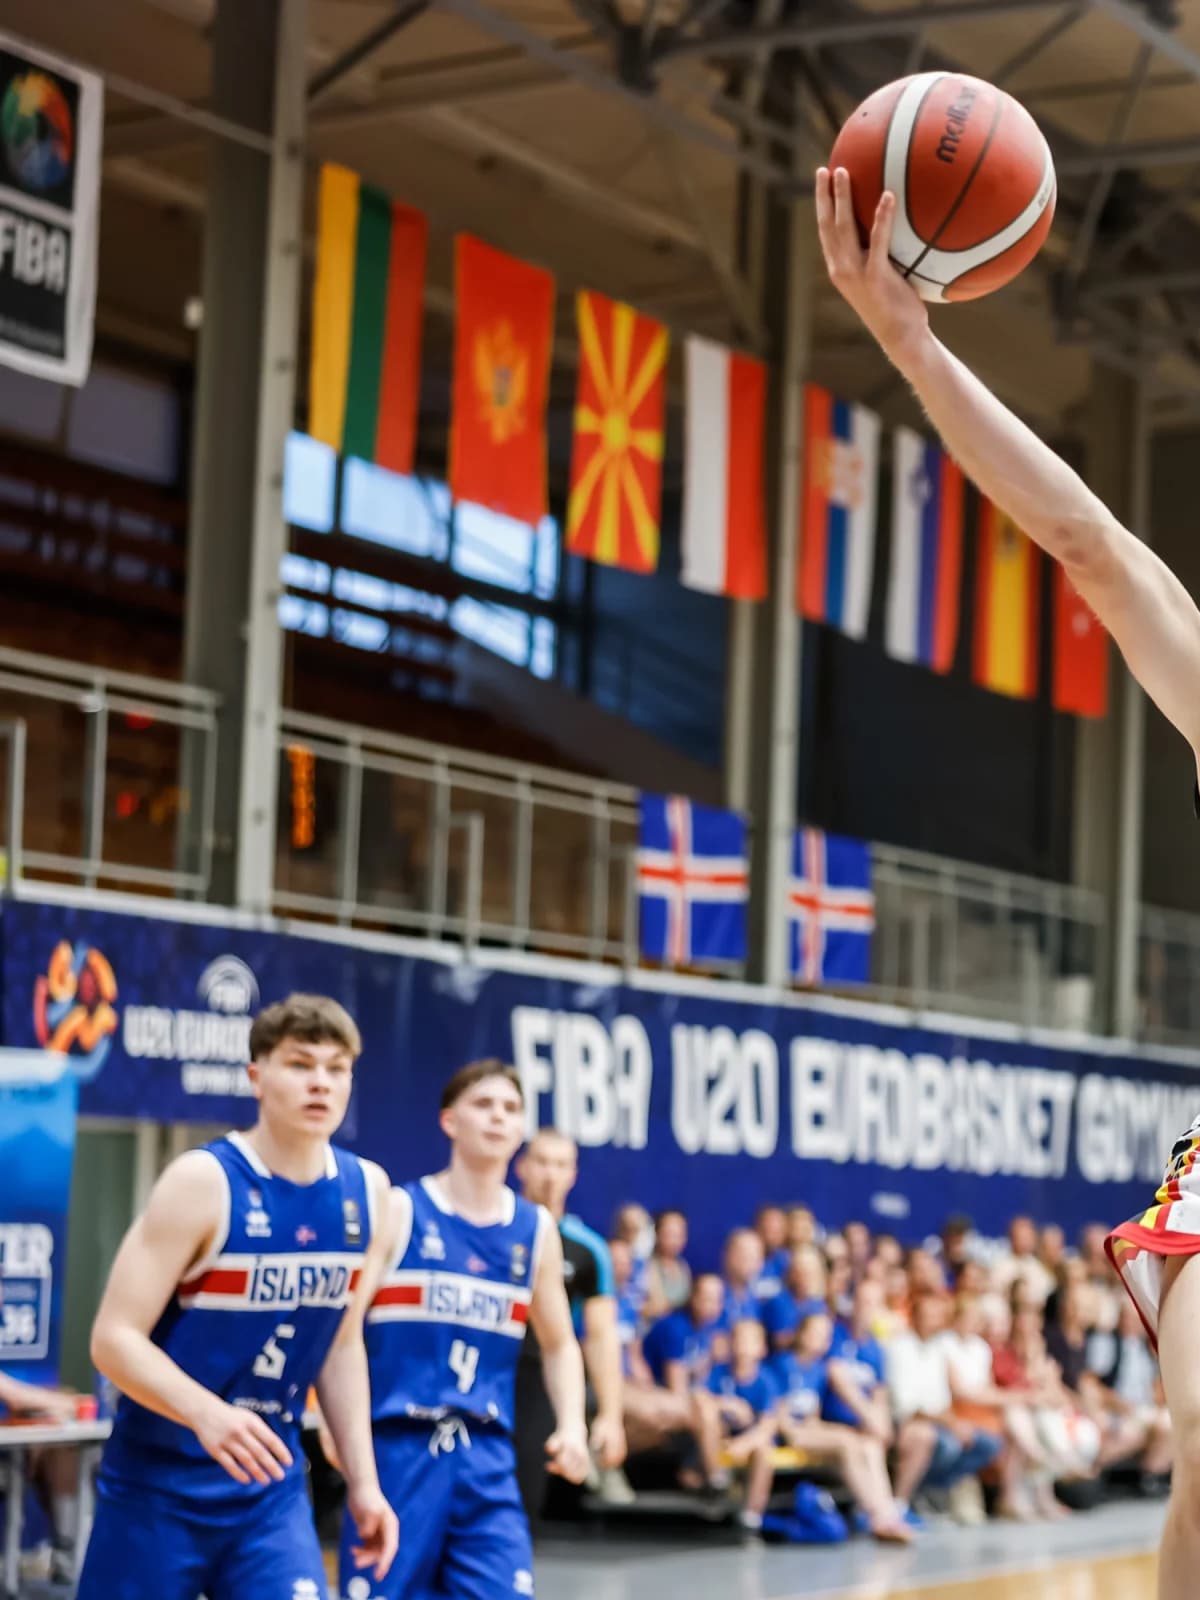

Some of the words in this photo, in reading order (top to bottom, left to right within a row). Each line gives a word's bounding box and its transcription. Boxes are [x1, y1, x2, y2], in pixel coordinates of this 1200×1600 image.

[511, 1004, 653, 1150] FIBA
[670, 1022, 781, 1158] U20
[789, 1036, 1077, 1179] EUROBASKET
[253, 1323, 296, 1381] 5
[449, 1338, 480, 1394] 4
